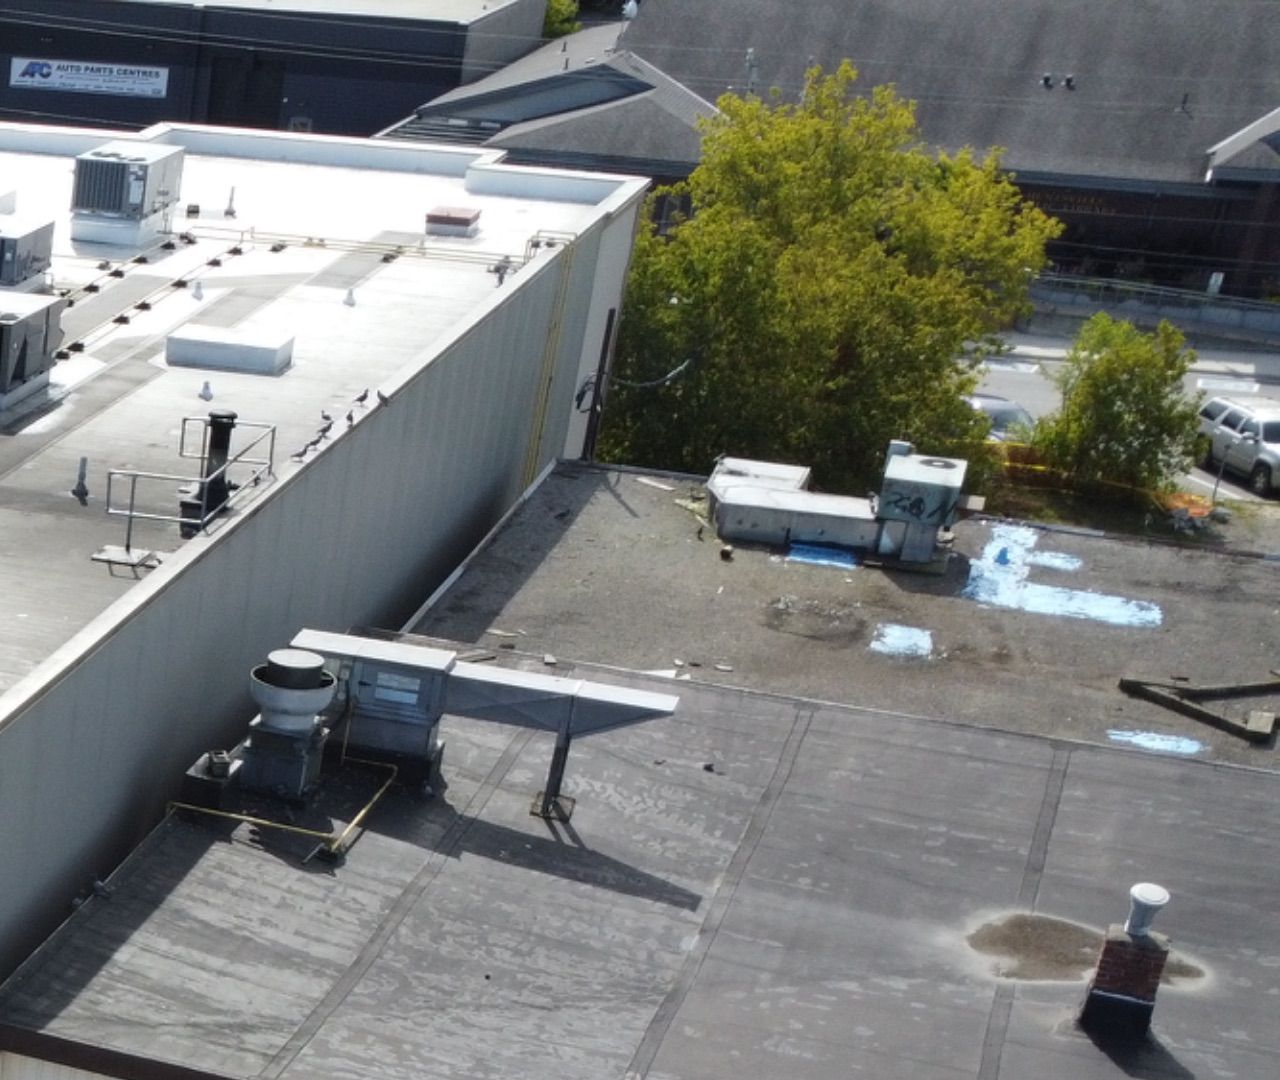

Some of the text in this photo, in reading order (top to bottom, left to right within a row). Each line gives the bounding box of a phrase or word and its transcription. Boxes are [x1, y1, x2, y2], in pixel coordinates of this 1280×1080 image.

[55, 63, 161, 79] AUTO PARTS CENTRES
